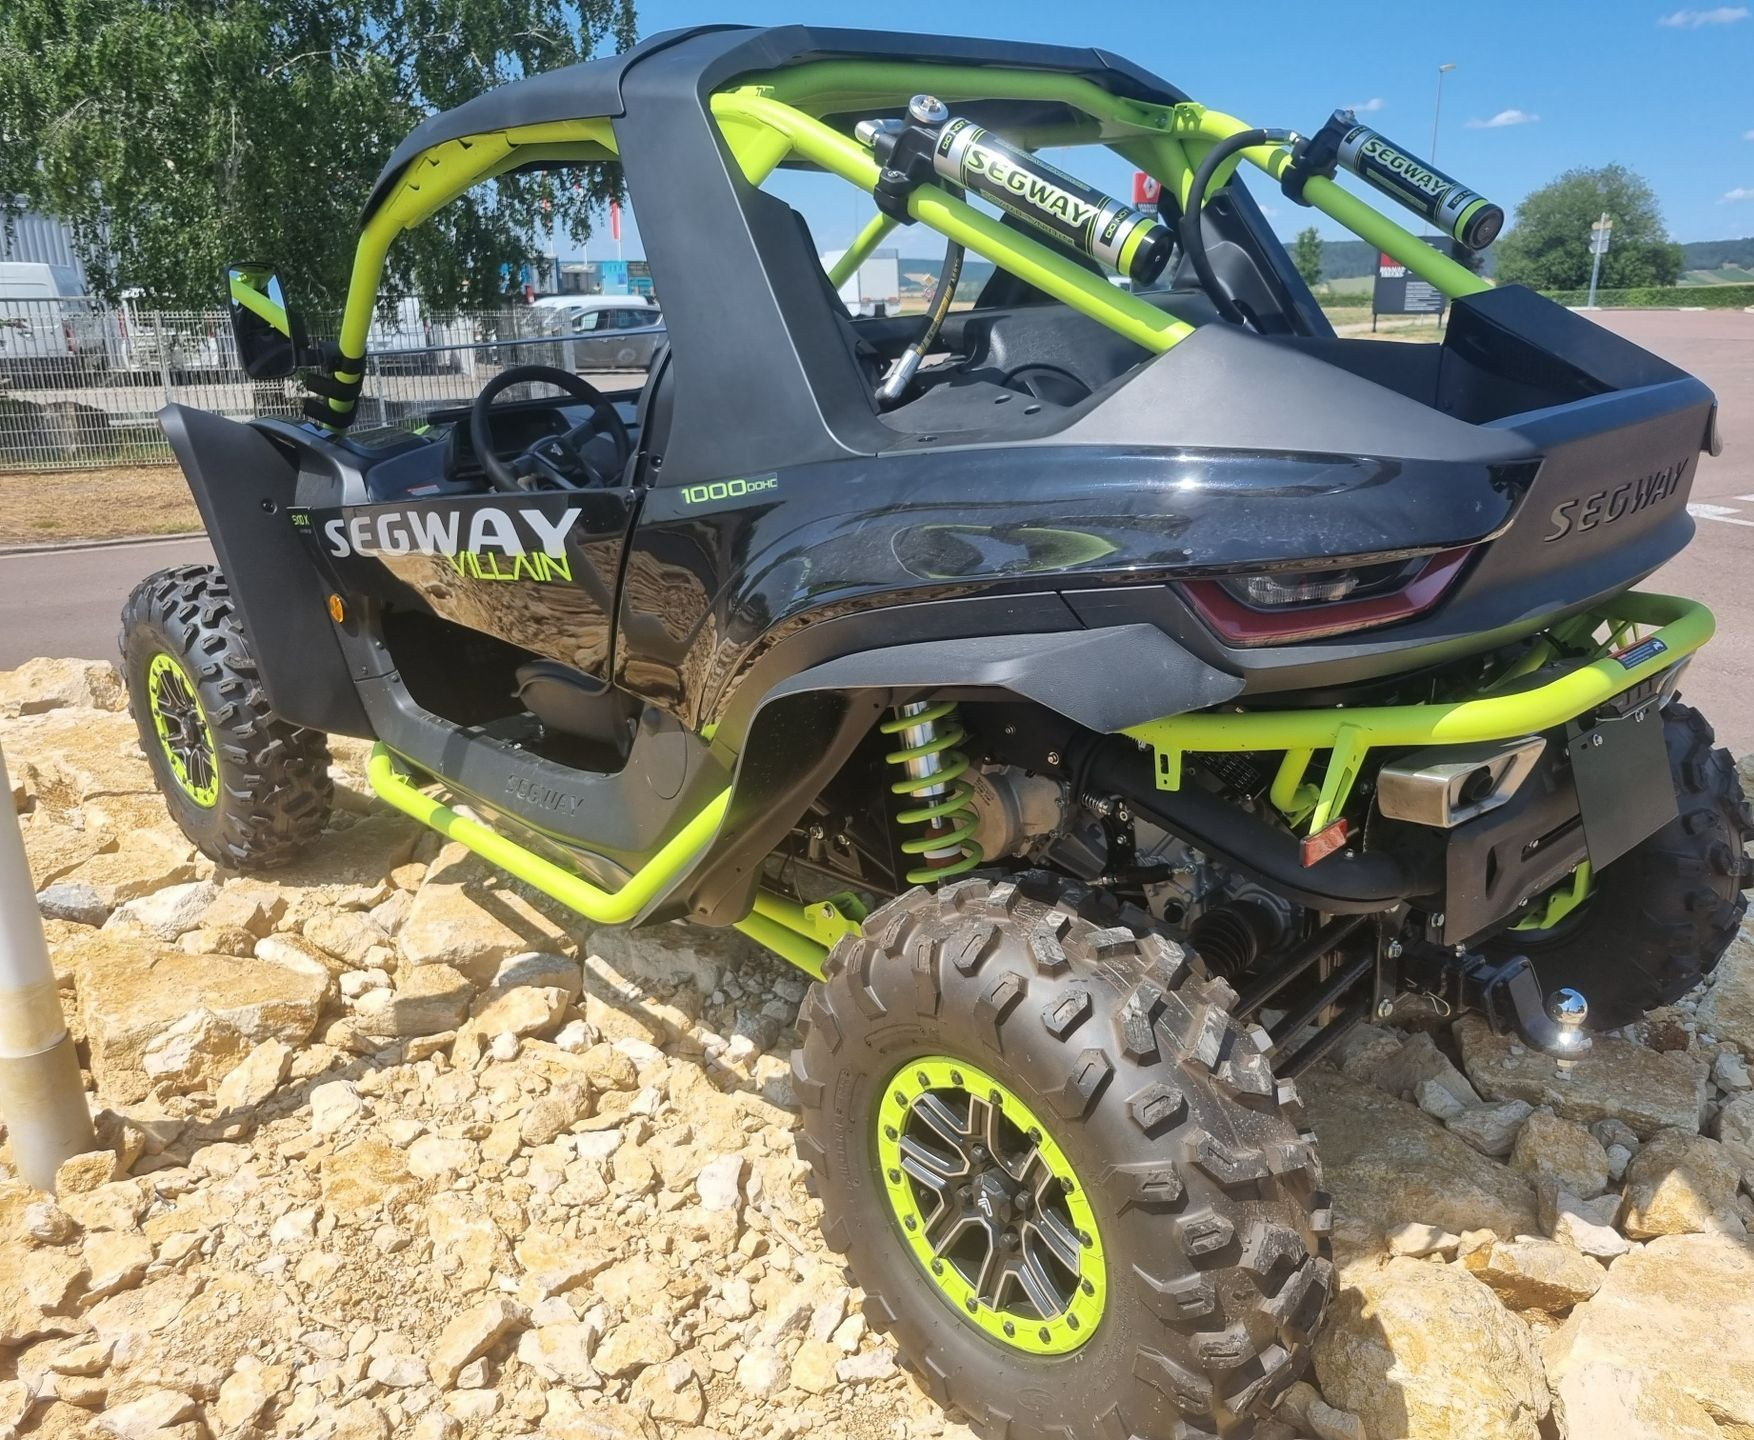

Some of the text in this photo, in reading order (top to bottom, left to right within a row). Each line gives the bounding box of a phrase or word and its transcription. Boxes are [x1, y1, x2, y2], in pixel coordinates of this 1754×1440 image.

[966, 147, 1092, 226] SEGWAY
[1364, 140, 1448, 194] SEGWAY
[1105, 223, 1117, 239] DO
[681, 479, 747, 504] 1000
[1543, 457, 1689, 543] SEGWAY
[324, 508, 583, 558] SEGWAY
[448, 550, 573, 582] VILLAIN
